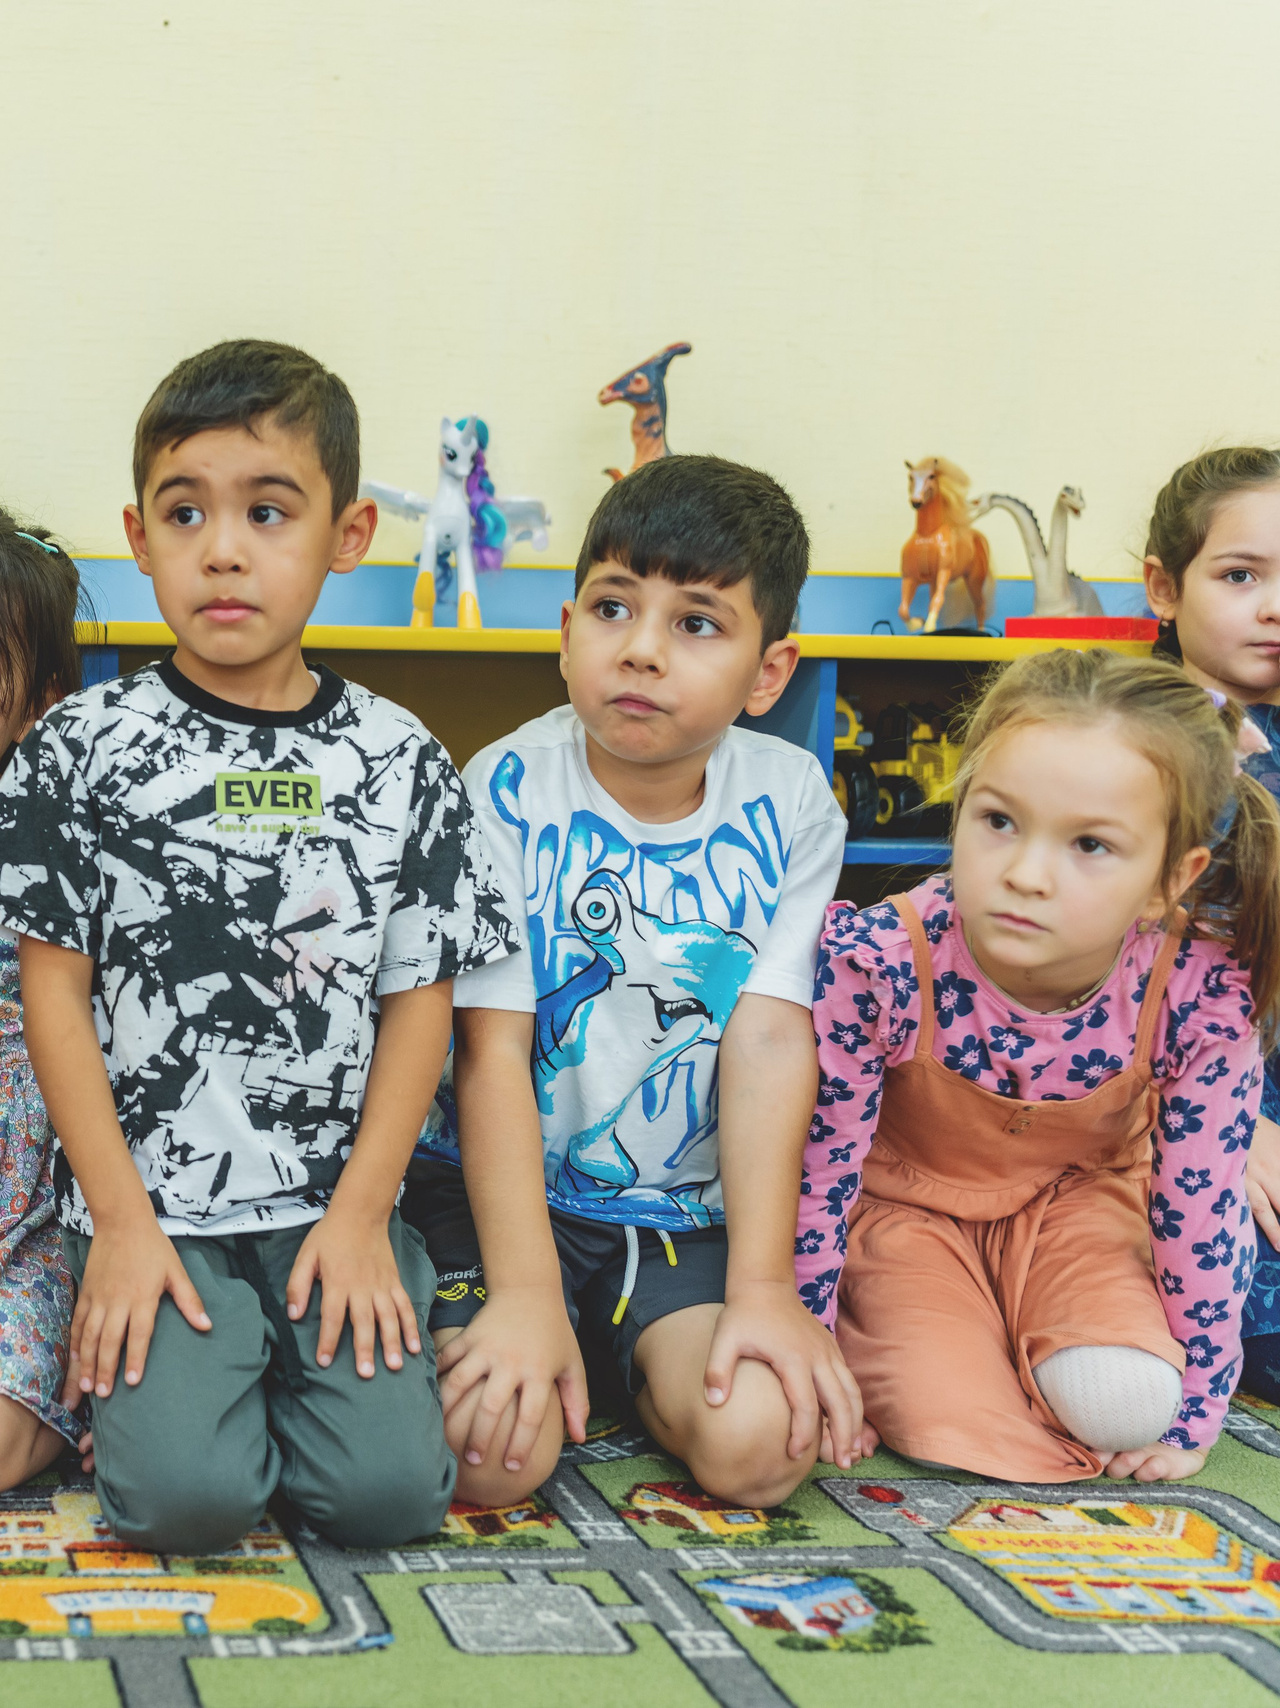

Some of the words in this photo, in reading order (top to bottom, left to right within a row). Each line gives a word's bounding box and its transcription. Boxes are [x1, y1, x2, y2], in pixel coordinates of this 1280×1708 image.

[224, 780, 314, 809] EVER
[215, 820, 246, 833] have
[250, 823, 258, 833] a
[301, 822, 320, 837] day
